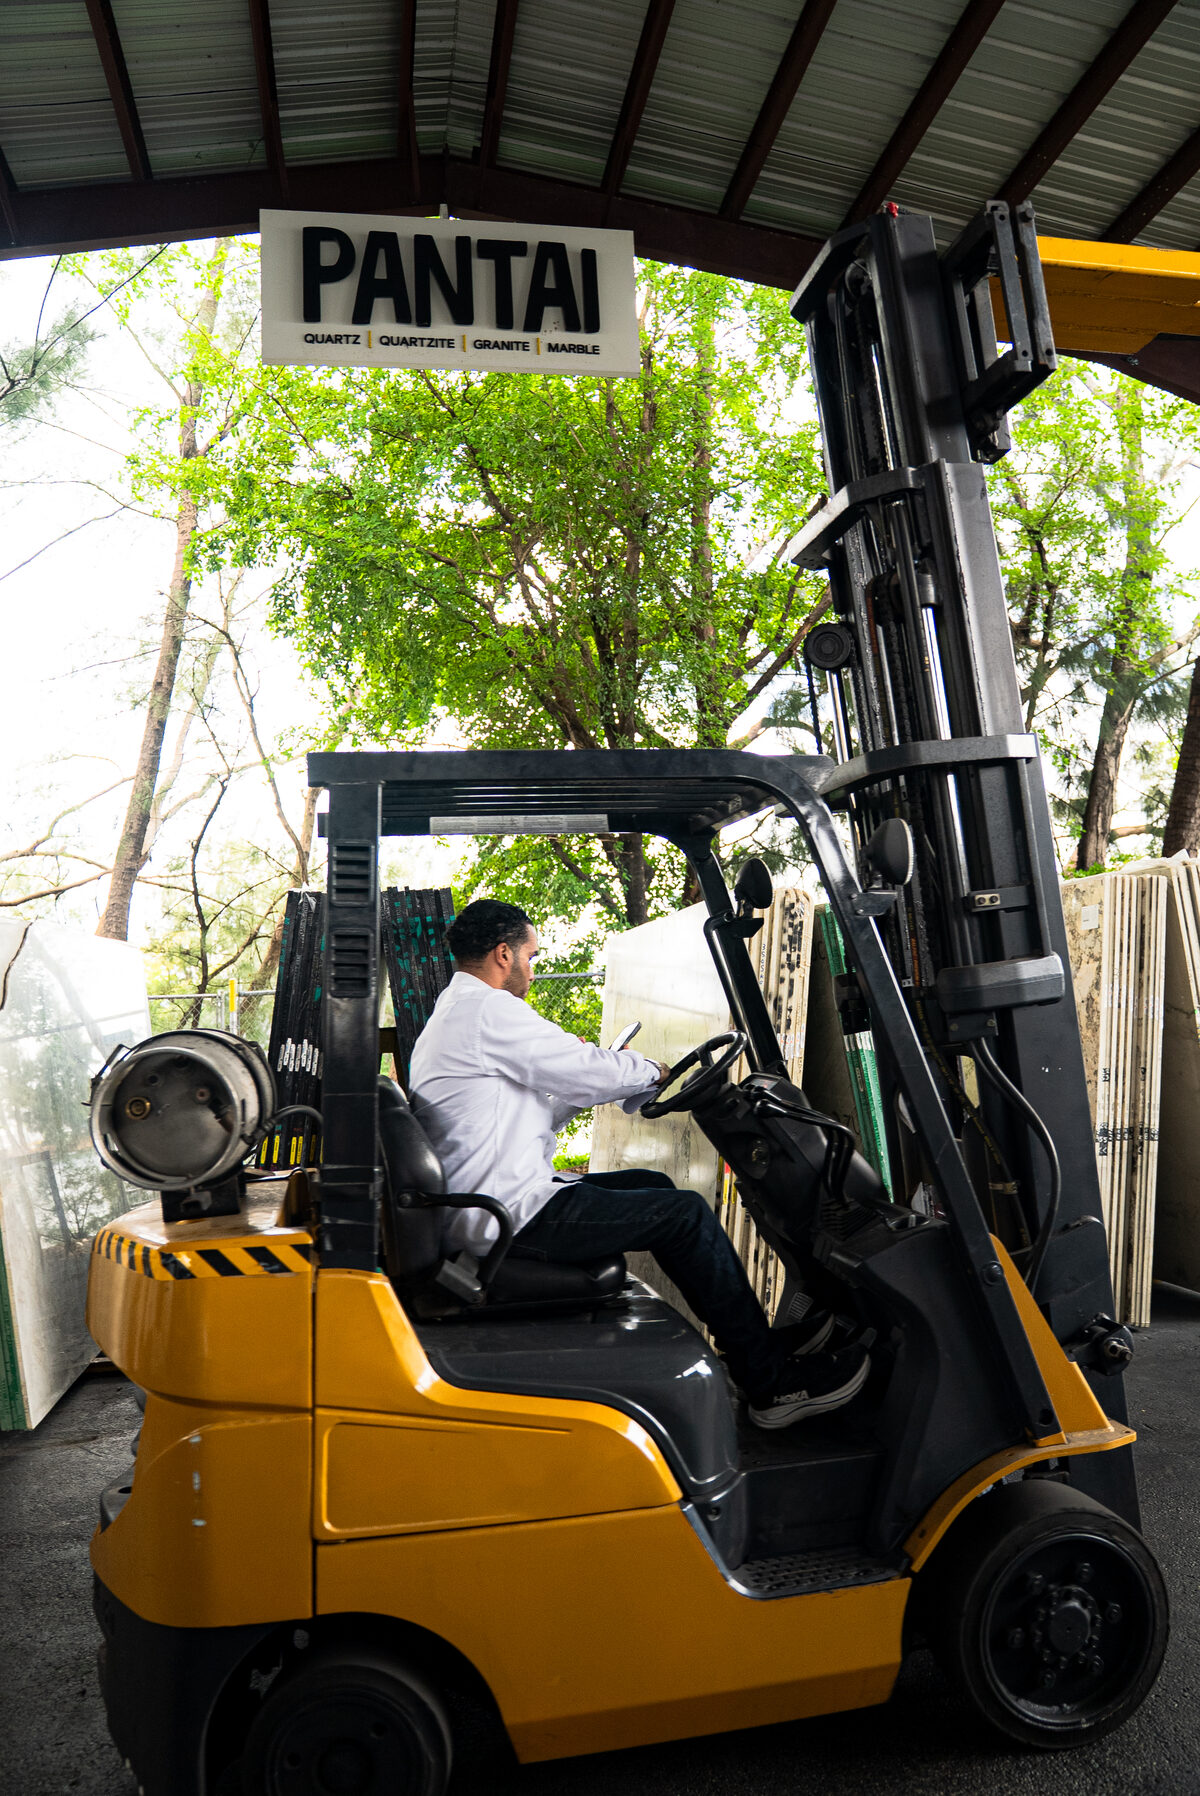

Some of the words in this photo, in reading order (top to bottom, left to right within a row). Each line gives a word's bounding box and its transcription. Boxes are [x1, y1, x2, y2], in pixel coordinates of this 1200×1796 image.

[302, 226, 601, 334] PANTAI
[303, 332, 361, 345] QUARTZ
[379, 335, 456, 349] QUARTZITE
[473, 339, 530, 352] GRANITE
[547, 342, 601, 355] MARBLE
[773, 1390, 809, 1404] HOKA
